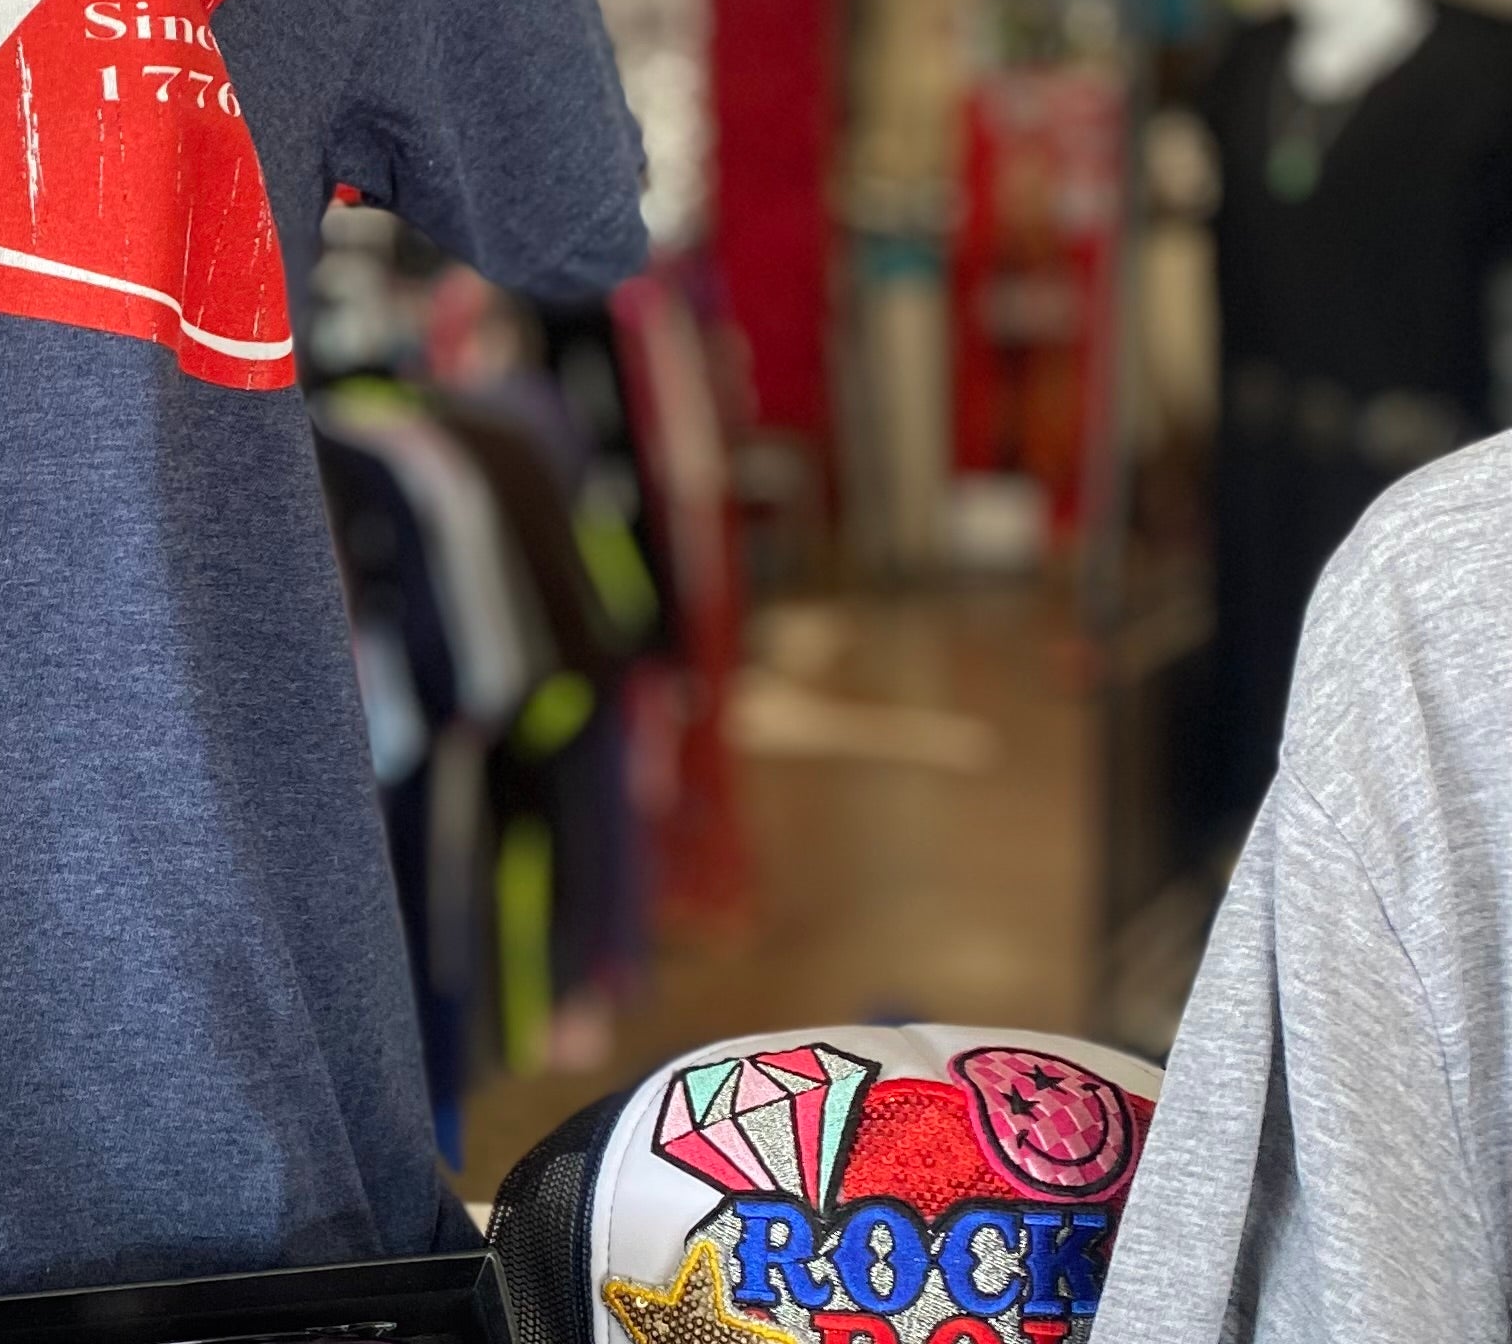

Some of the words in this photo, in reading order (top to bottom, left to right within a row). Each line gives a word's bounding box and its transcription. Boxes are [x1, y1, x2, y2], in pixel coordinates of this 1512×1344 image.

[84, 1, 222, 57] Sinc
[99, 65, 242, 118] 1776
[734, 1198, 1108, 1318] ROCK
